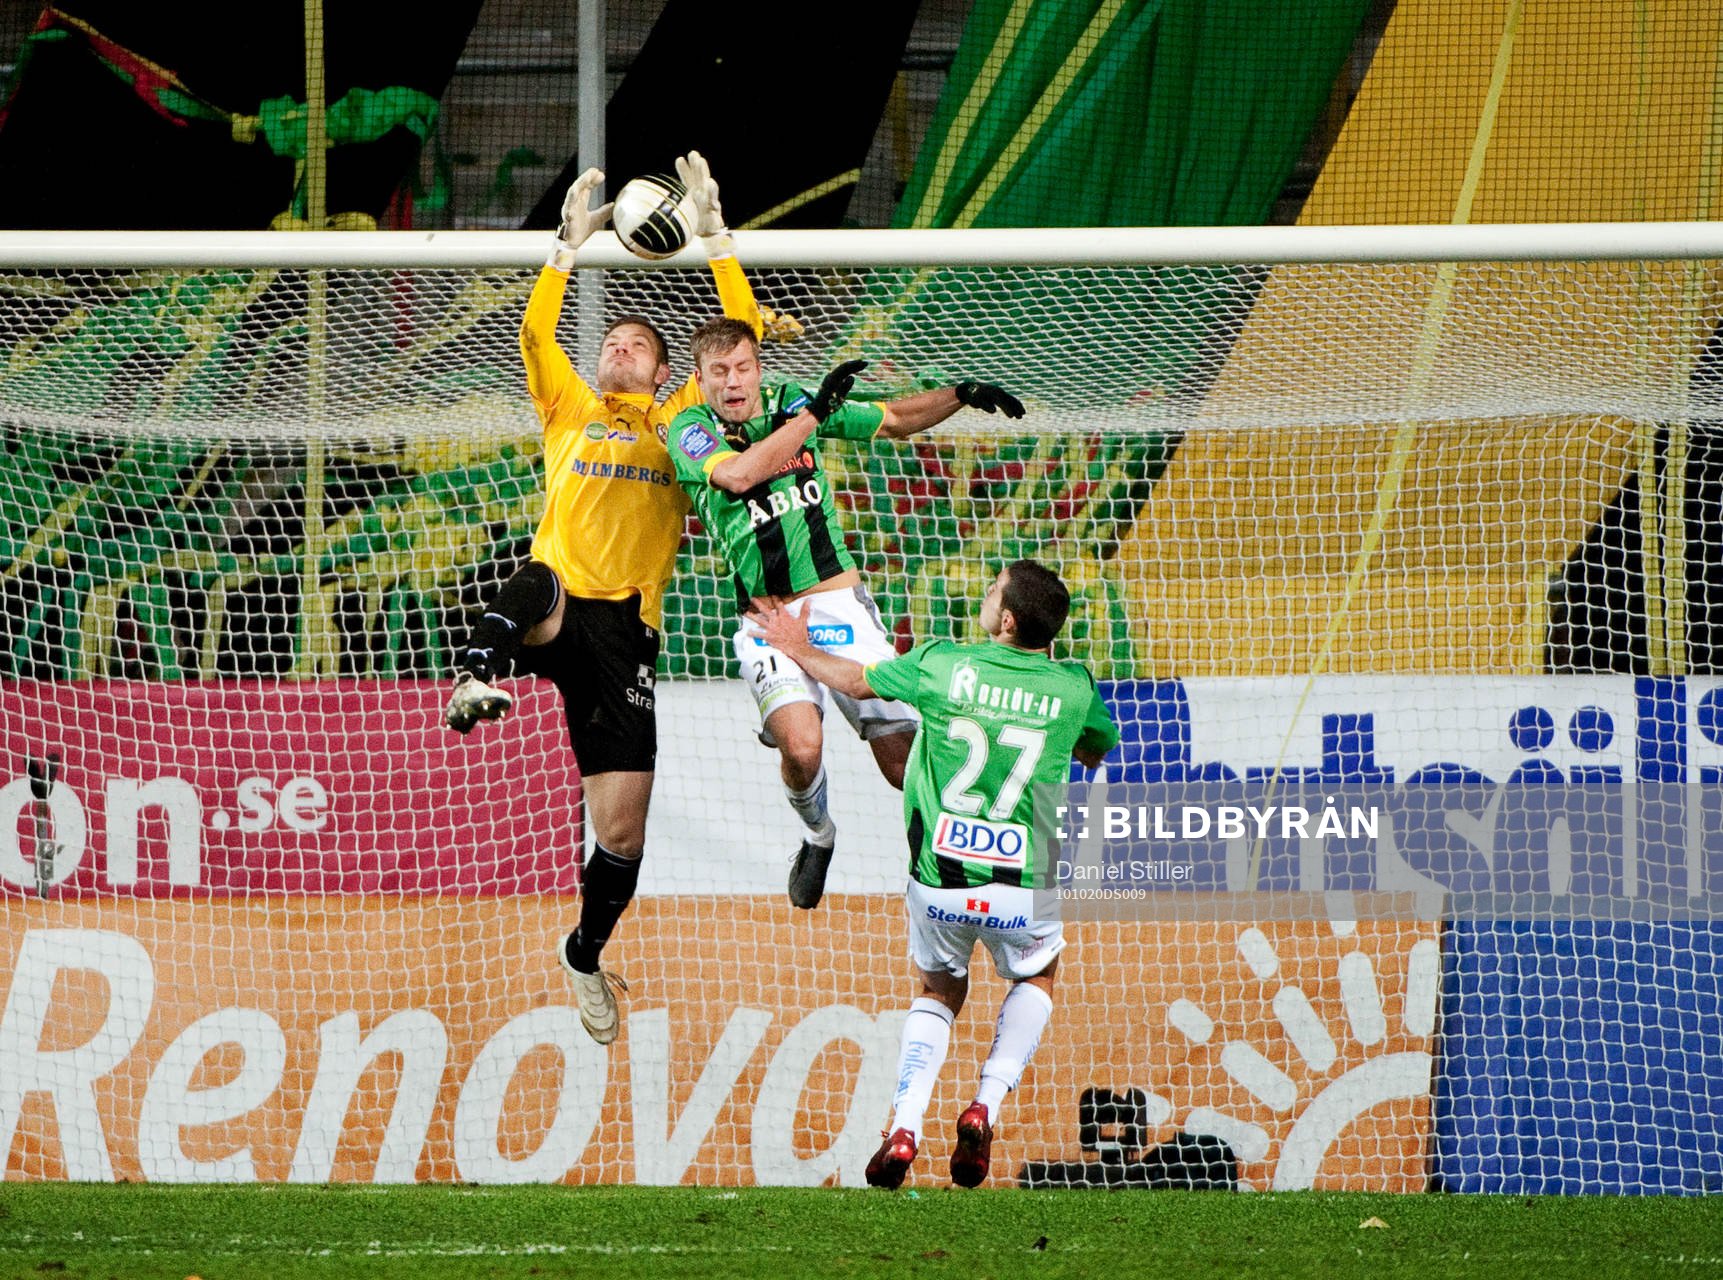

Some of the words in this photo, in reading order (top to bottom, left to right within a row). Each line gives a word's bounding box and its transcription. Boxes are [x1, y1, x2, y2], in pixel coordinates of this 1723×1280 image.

[748, 479, 822, 530] ÅBRO
[753, 654, 777, 684] 21
[941, 716, 1047, 820] 27
[0, 776, 328, 888] on.se
[949, 819, 1023, 857] BDO
[927, 905, 982, 926] Stena
[984, 915, 1028, 930] Bulk
[0, 929, 906, 1186] Renova
